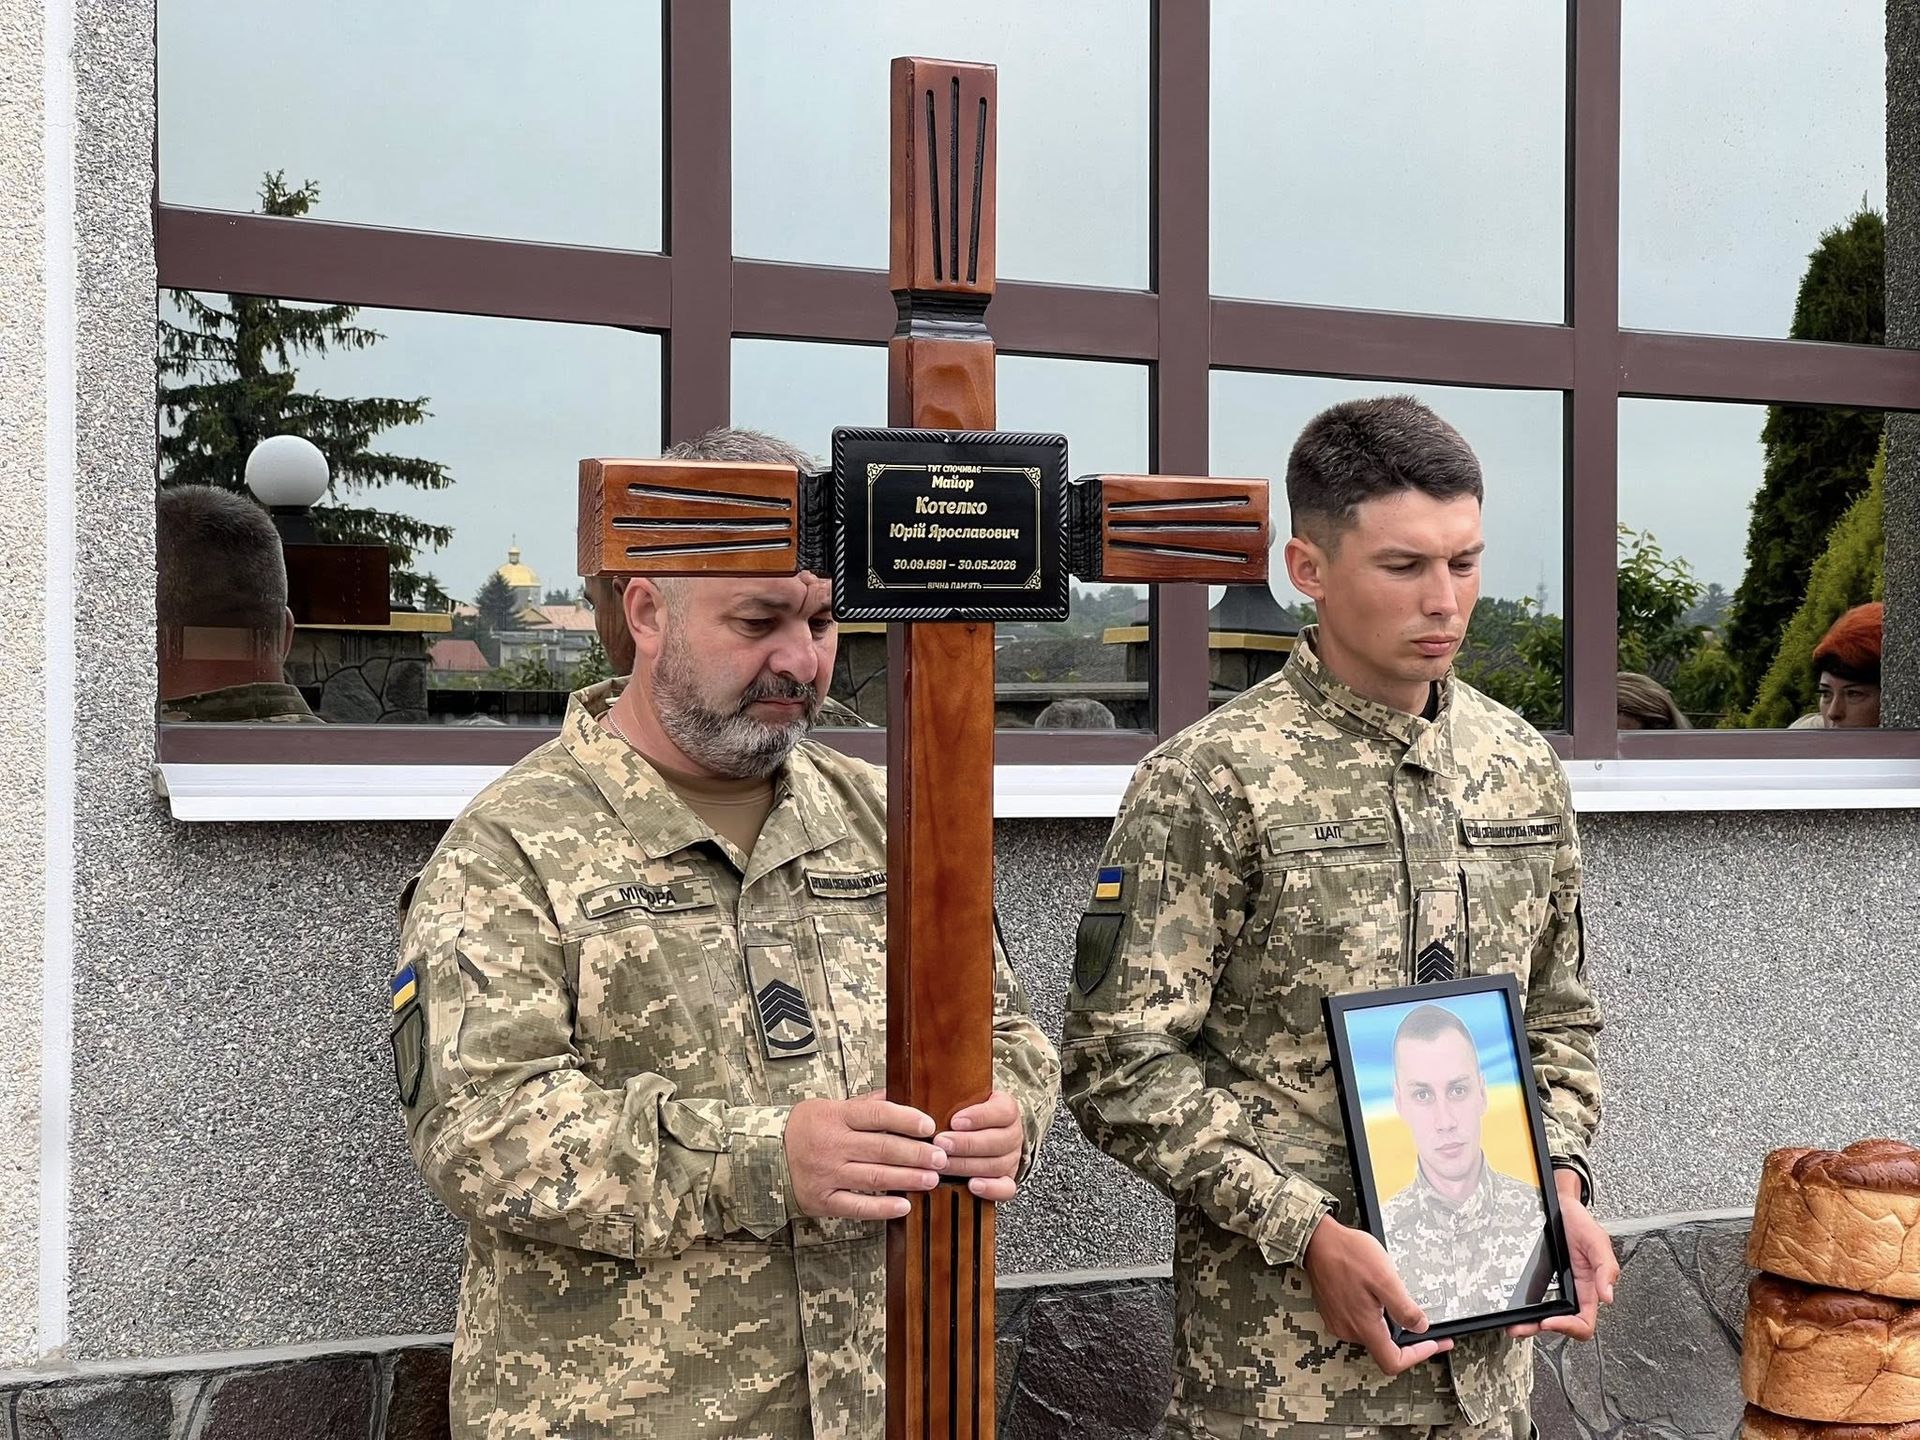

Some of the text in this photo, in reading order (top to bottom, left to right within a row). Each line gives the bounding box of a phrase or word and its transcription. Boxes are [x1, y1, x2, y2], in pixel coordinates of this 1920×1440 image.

[928, 464, 982, 474] ТУТ СПОЧИВАЄ
[931, 475, 974, 492] Майор
[915, 496, 988, 515] Котелко
[889, 522, 1020, 542] Юрій Ярославович
[957, 559, 1017, 571] 30.05.2026
[927, 582, 949, 590] ВІЧНА
[1314, 826, 1342, 842] ЦАП
